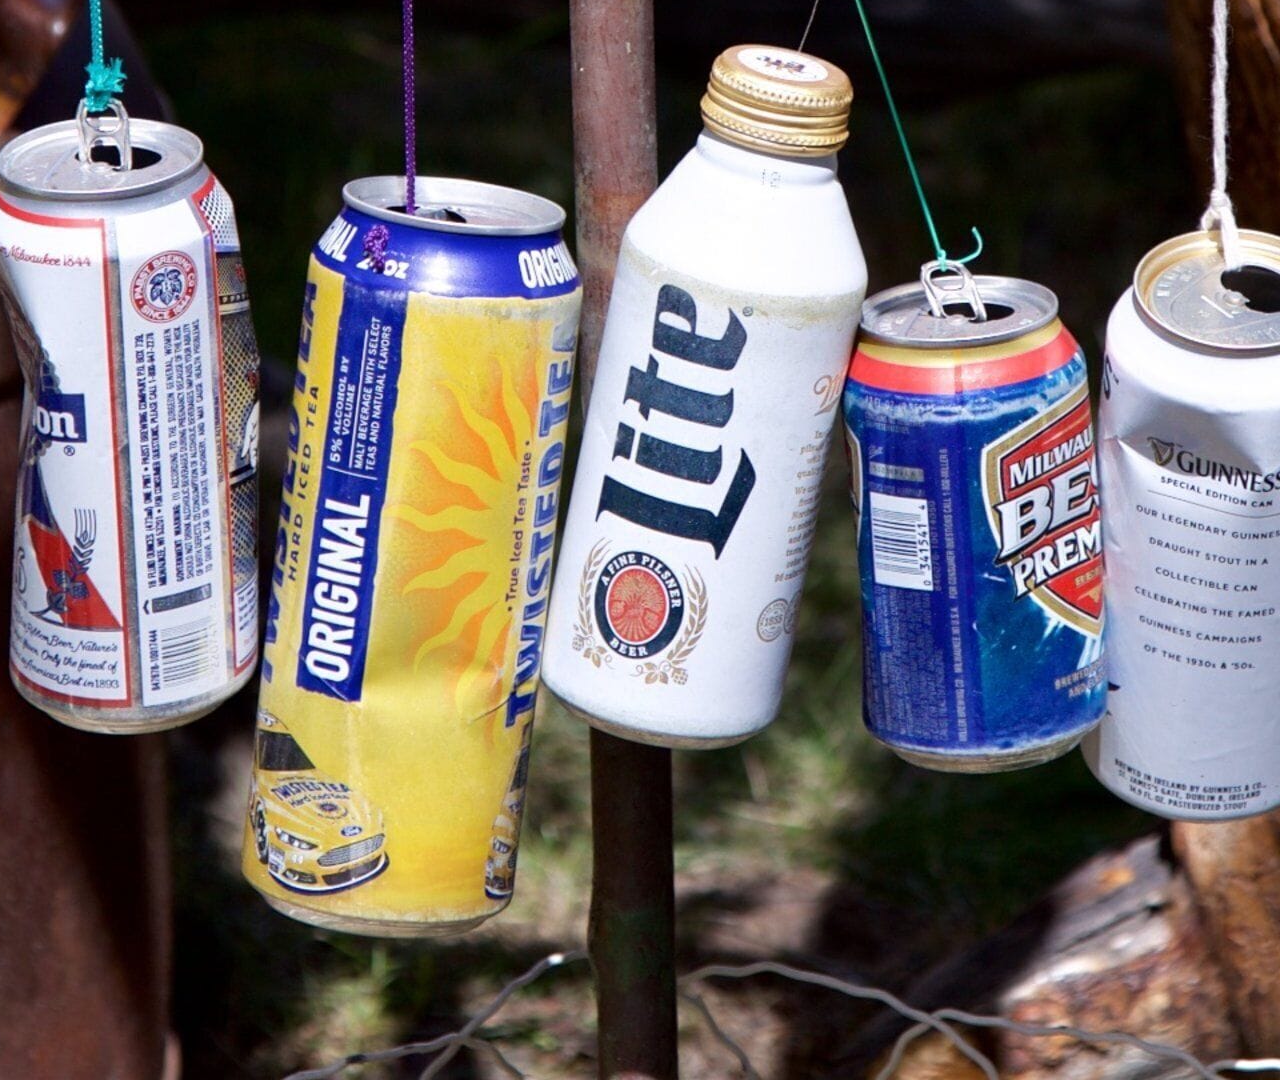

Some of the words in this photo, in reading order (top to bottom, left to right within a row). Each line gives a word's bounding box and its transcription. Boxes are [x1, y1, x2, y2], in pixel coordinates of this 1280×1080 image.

[368, 316, 381, 356] SELECT
[377, 325, 392, 370] FLAVORS
[340, 355, 349, 373] BY
[364, 358, 375, 384] WITH
[333, 376, 348, 434] ALCOHOL
[342, 384, 356, 435] VOLUME
[372, 373, 386, 419] NATURAL
[357, 387, 372, 440] BEVERAGE
[595, 284, 756, 560] Lite
[369, 421, 379, 443] AND
[329, 438, 343, 463] 5%
[354, 442, 366, 469] MALT
[365, 446, 377, 471] TEAS
[287, 512, 305, 582] HARD
[297, 444, 313, 499] ICED
[305, 385, 320, 427] TEA
[517, 452, 532, 492] Taste
[1160, 476, 1202, 494] SPECIAL
[1206, 489, 1248, 506] EDITION
[1251, 500, 1273, 508] CAN
[513, 497, 527, 525] Tea
[1136, 504, 1158, 517] OUR
[1161, 513, 1228, 536] LEGENDARY
[511, 530, 524, 563] Iced
[918, 523, 931, 570] 341541
[1012, 522, 1102, 597] PREM
[1148, 536, 1201, 558] DRAUGHT
[1205, 552, 1241, 566] STOUT
[304, 494, 370, 682] ORIGINAL
[505, 441, 565, 727] TWISTED
[505, 568, 519, 602] True
[601, 575, 610, 586] A
[607, 553, 637, 575] FINE
[641, 555, 682, 608] PILSNER
[1155, 566, 1229, 591] COLLECTIBLE
[1233, 584, 1258, 592] CAN
[1134, 585, 1208, 614] CELEBRATING
[1212, 608, 1233, 618] THE
[1238, 608, 1276, 618] FAMED
[1139, 615, 1192, 638] GUINNESS
[1196, 633, 1263, 644] CAMPAIGNS
[41, 649, 62, 668] Only
[610, 637, 648, 657] BEER
[1143, 644, 1158, 654] OF
[1161, 650, 1182, 662] THE
[1154, 775, 1187, 791] IRELAND
[1190, 785, 1200, 793] BY
[1202, 785, 1242, 794] GUINNESS
[1185, 793, 1216, 802] DUBLIN
[1228, 790, 1261, 802] IRELAND
[1168, 798, 1221, 811] PASTEURIZED
[1223, 801, 1248, 811] STOUT
